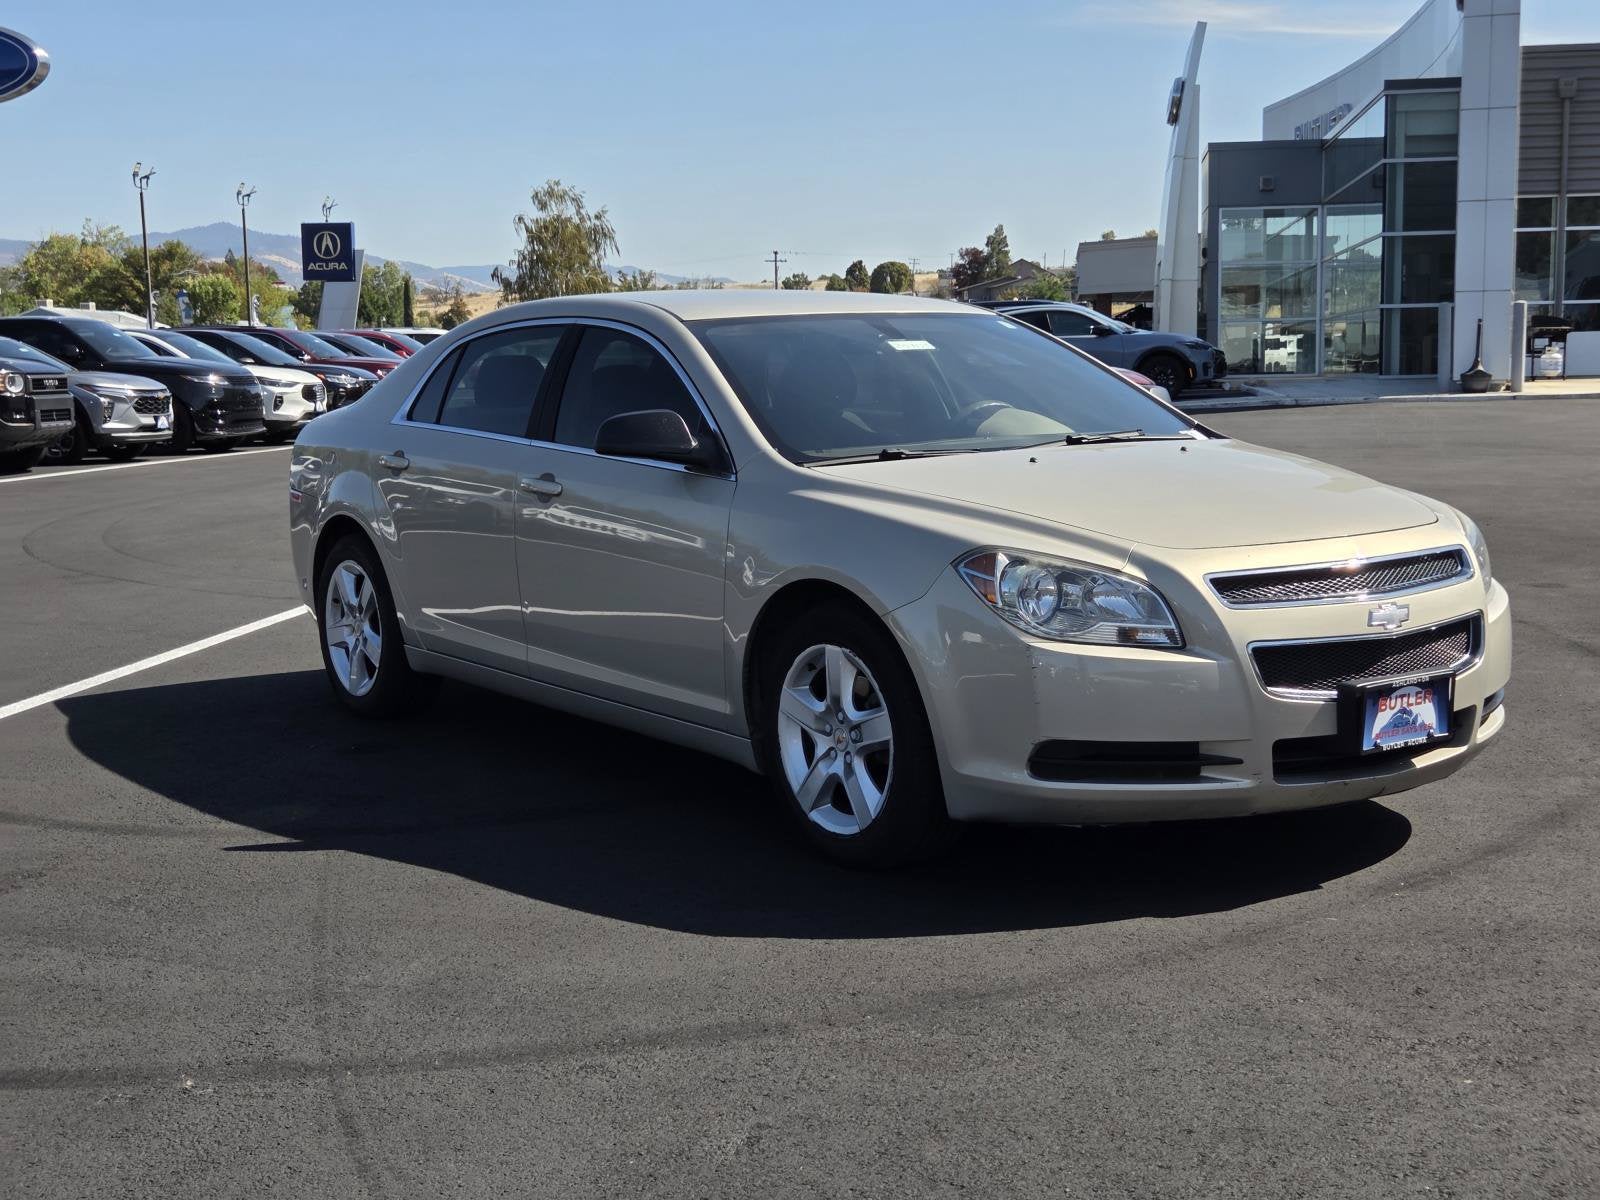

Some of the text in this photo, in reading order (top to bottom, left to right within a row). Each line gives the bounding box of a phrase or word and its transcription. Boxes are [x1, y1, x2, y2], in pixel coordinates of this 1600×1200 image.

[307, 262, 348, 271] ACURA
[1378, 688, 1433, 712] BUTLER
[1382, 737, 1427, 751] BUTLER ACURA
